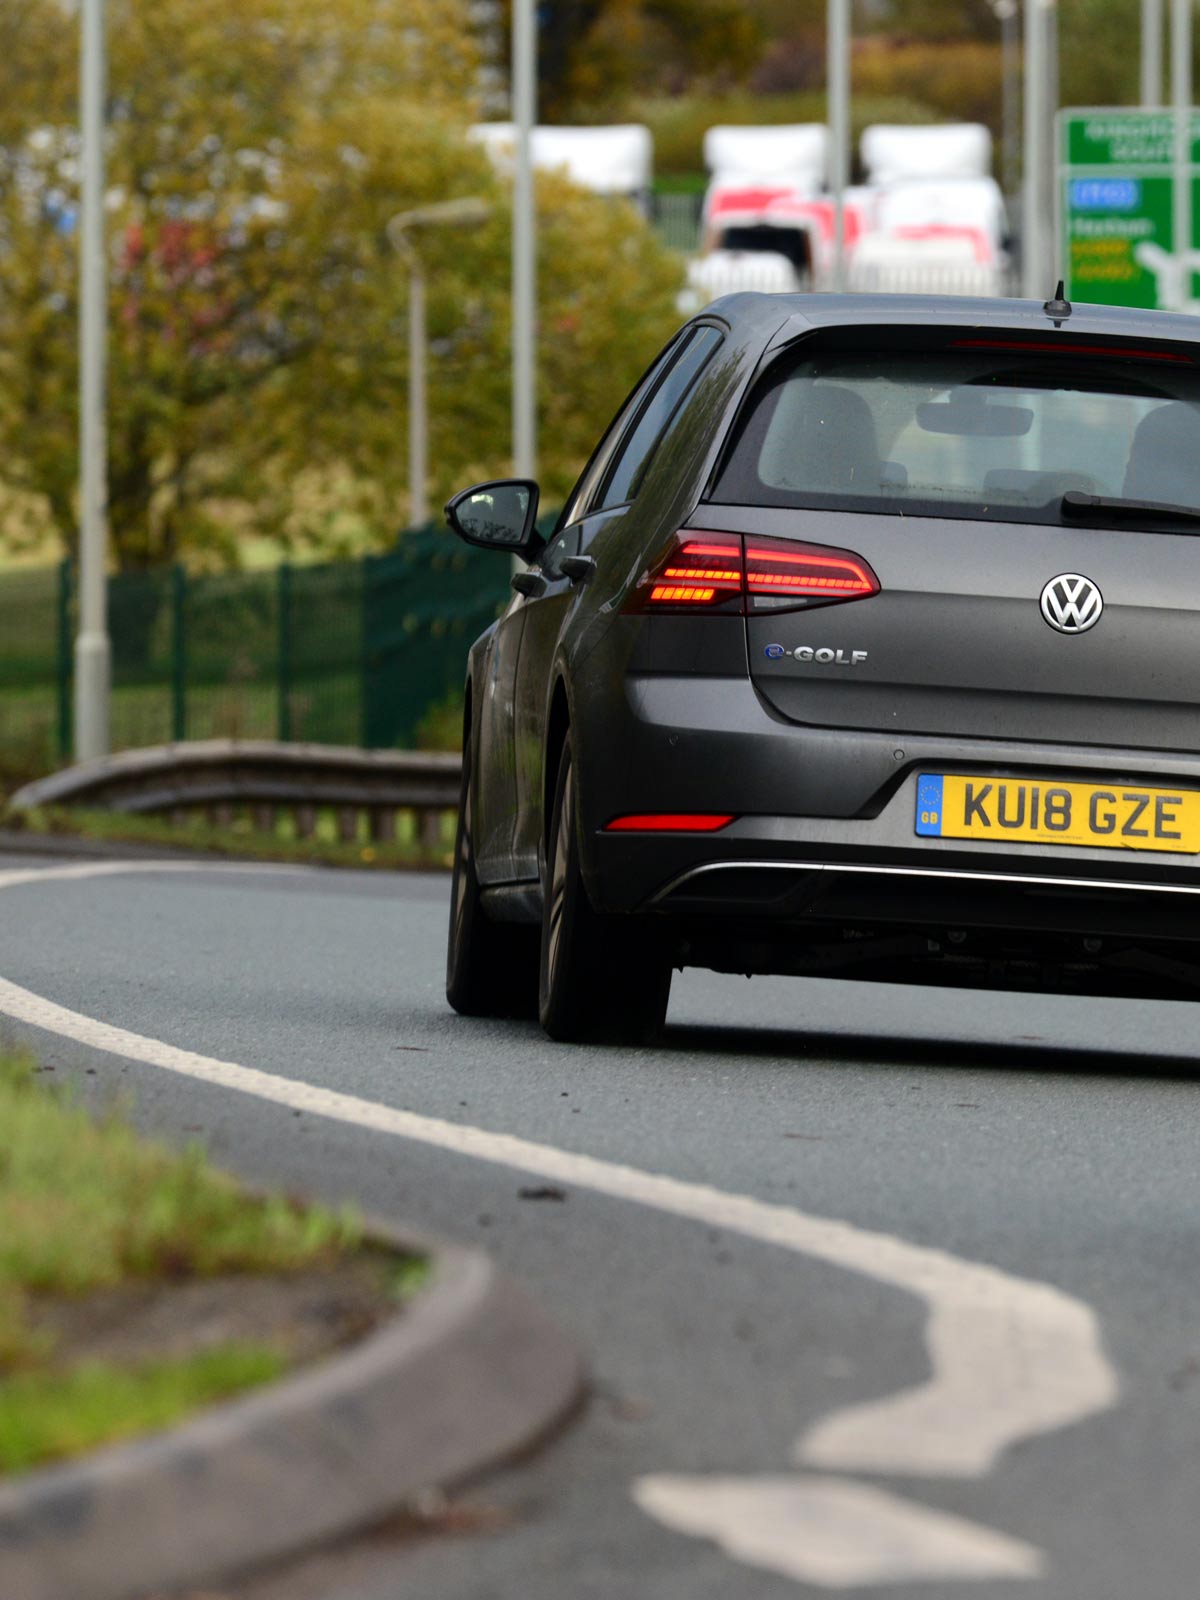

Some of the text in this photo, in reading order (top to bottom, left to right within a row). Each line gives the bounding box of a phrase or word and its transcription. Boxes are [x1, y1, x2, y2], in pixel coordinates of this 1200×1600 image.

[1042, 574, 1100, 632] VW
[764, 643, 868, 666] e-GOLF
[921, 811, 939, 825] GB
[963, 783, 1183, 840] KU18 GZE
